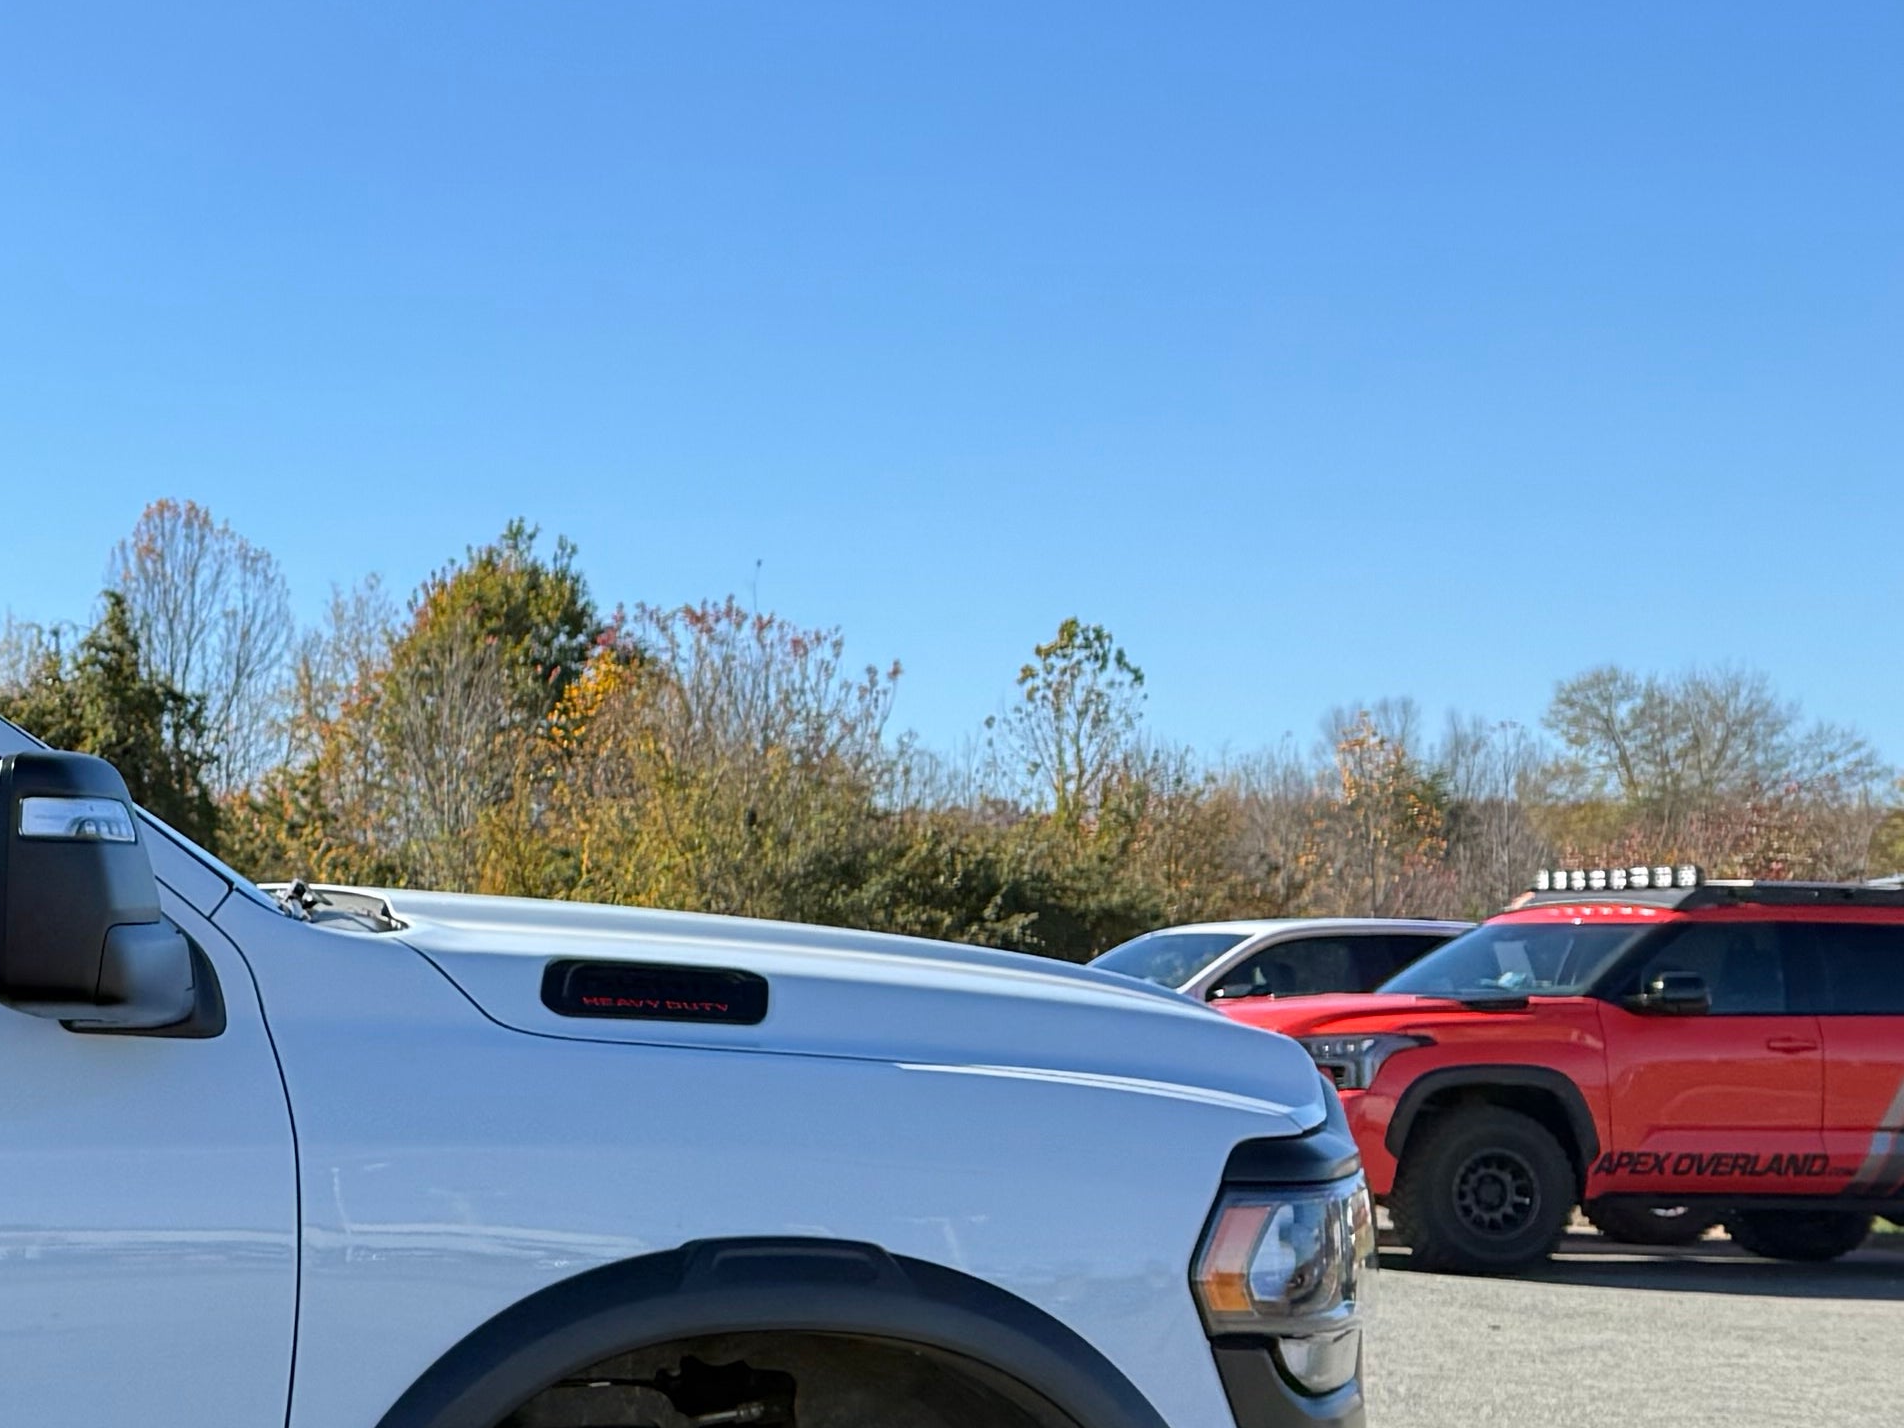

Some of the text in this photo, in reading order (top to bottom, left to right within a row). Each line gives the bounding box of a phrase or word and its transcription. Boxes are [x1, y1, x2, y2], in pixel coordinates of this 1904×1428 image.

[582, 996, 728, 1012] HEAVY DUTY
[1594, 1151, 1671, 1176] APEX
